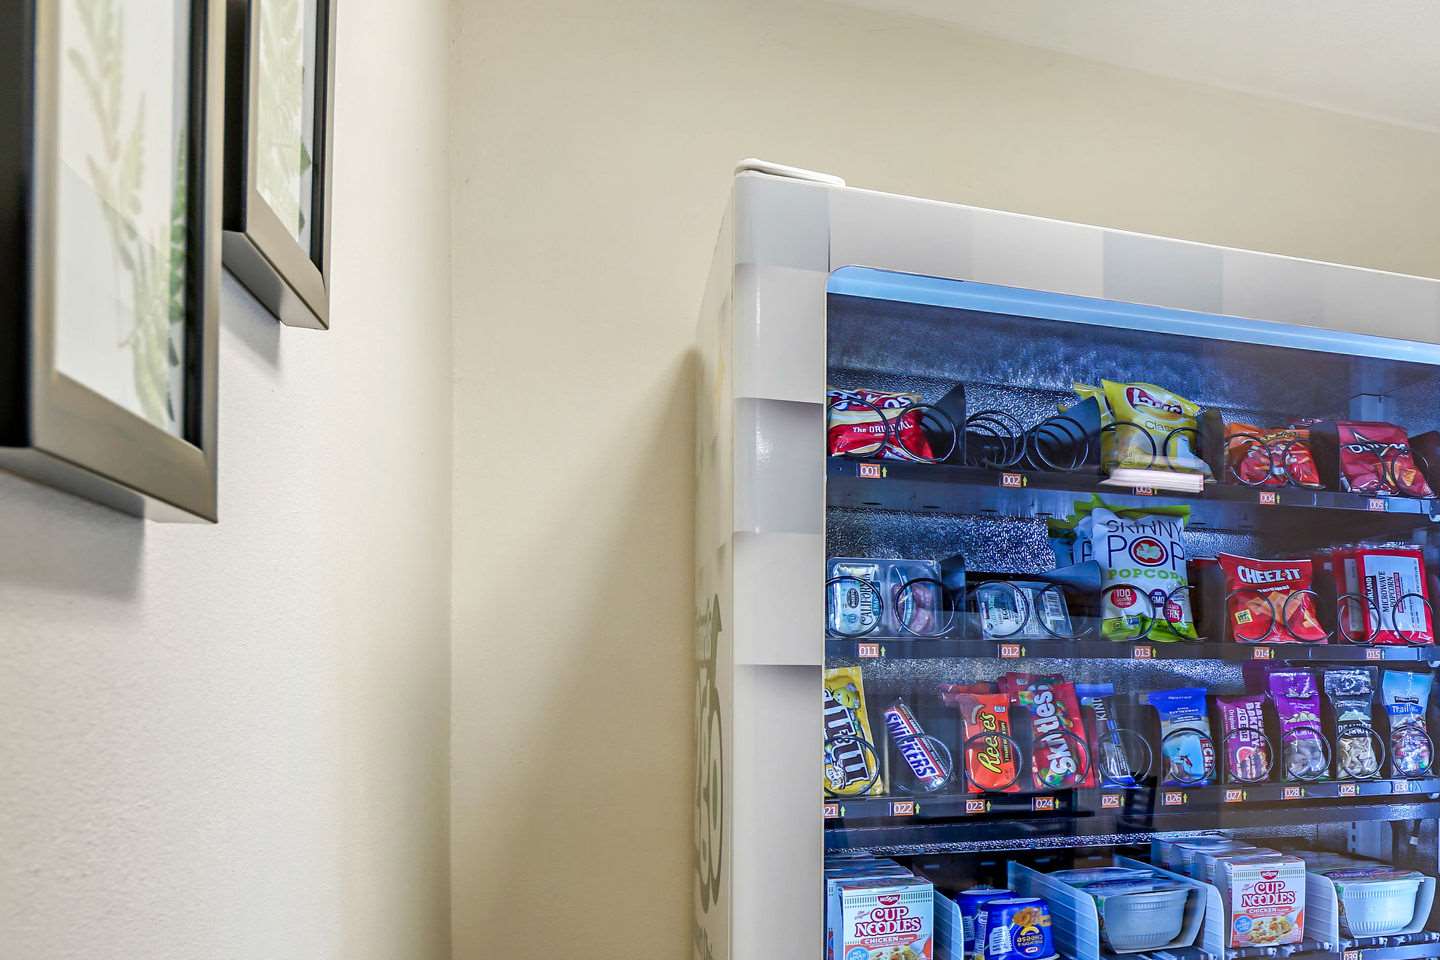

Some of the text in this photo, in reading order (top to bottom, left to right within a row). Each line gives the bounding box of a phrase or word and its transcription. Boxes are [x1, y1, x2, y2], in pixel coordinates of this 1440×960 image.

[860, 467, 879, 476] 001
[1003, 475, 1021, 486] 002
[1261, 494, 1275, 503] 004
[1370, 501, 1383, 509] 005
[1107, 520, 1182, 541] SKINNY
[1107, 535, 1185, 570] POP
[859, 647, 879, 655] 011
[1002, 647, 1020, 656] 012
[1135, 648, 1151, 657] 013
[1254, 650, 1269, 658] 014
[1366, 650, 1380, 659] 015
[976, 711, 1003, 774] Reee's
[1286, 788, 1300, 797] 028
[1340, 785, 1355, 794] 029
[1394, 784, 1408, 792] 030
[1166, 794, 1182, 802] 026
[1226, 791, 1241, 799] 027
[1036, 799, 1053, 808] 024
[1102, 796, 1119, 805] 025
[894, 804, 912, 813] 022
[966, 802, 984, 811] 023
[1255, 881, 1286, 895] CUP
[1241, 890, 1296, 907] NOODLES
[871, 906, 909, 922] CUP
[854, 917, 921, 937] NOODLES
[1344, 952, 1358, 960] 039
